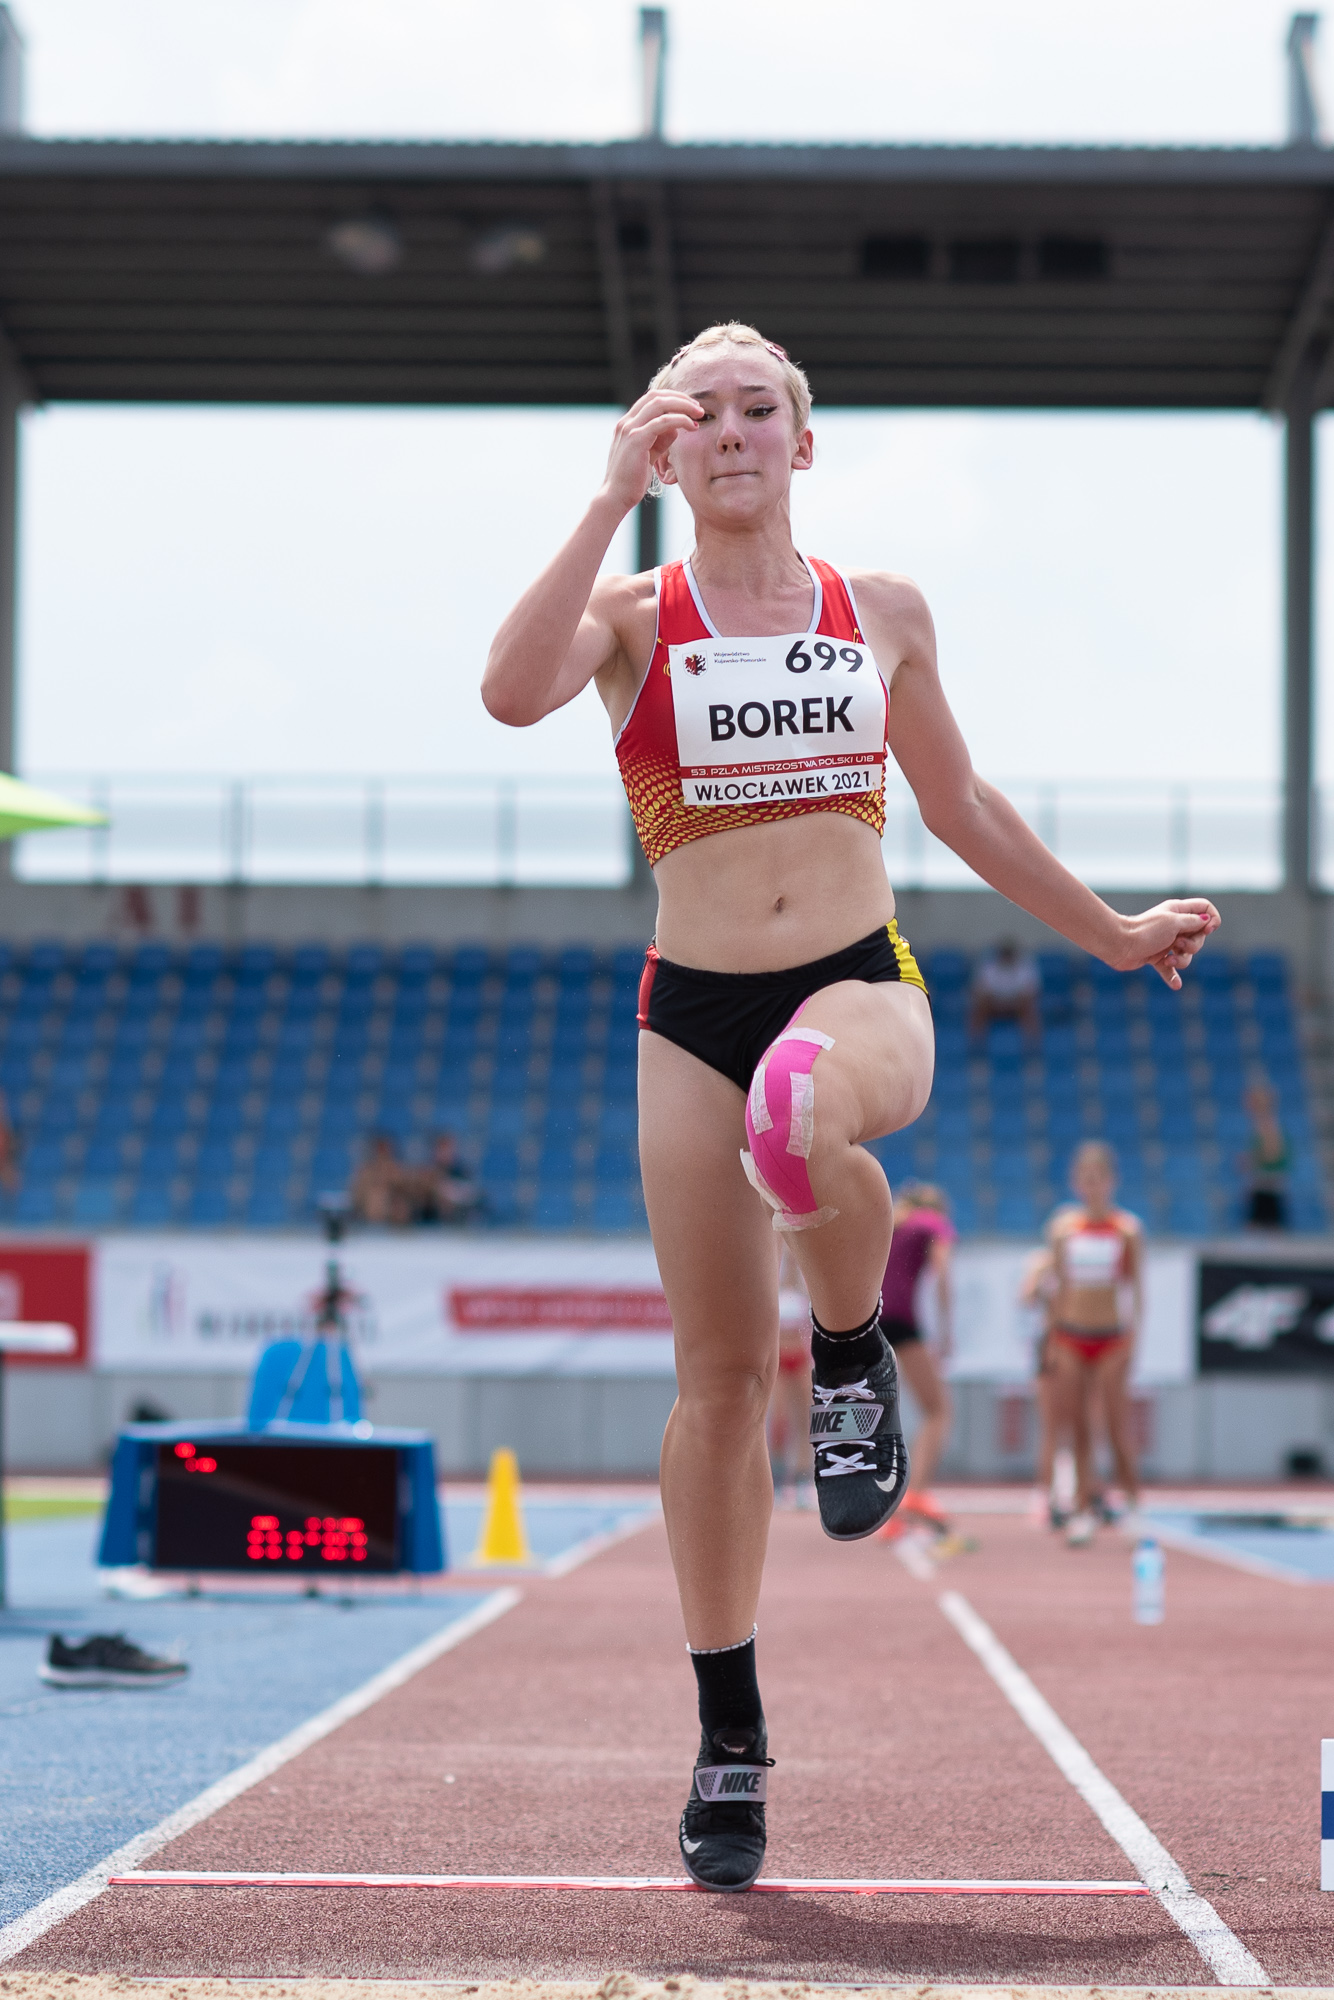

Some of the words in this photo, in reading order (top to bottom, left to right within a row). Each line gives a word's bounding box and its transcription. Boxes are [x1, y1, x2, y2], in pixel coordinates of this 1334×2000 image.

[785, 640, 863, 673] 699
[709, 696, 854, 741] BOREK
[711, 767, 739, 775] PZLA
[741, 760, 818, 774] MISTRZOSTWA
[818, 756, 853, 766] POLSKI
[856, 755, 874, 763] U18
[694, 775, 828, 801] WŁOCŁAWEK
[831, 770, 870, 791] 2021
[809, 1411, 847, 1435] NIKE
[717, 1772, 762, 1794] NIKE
